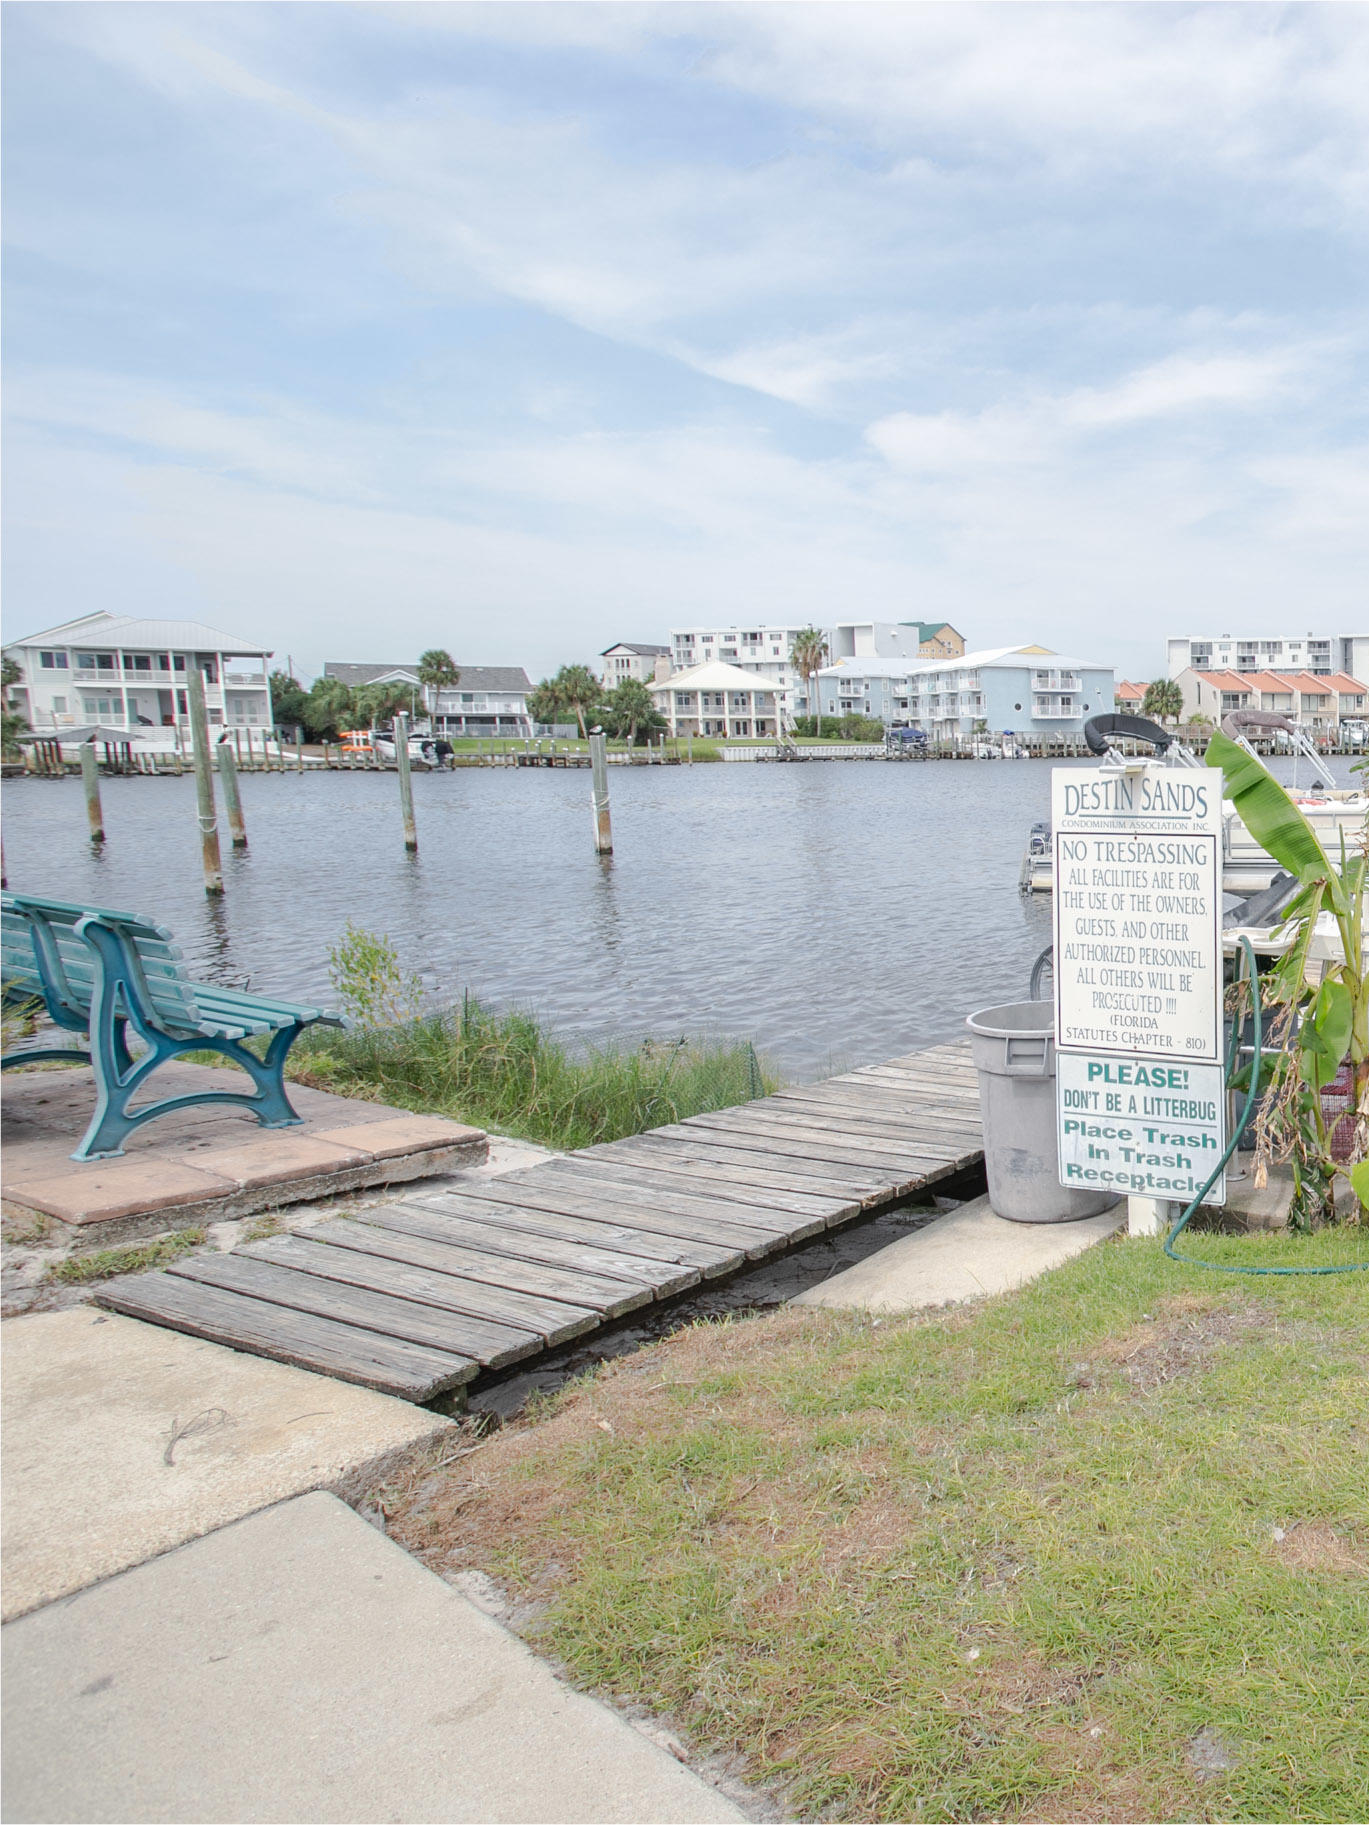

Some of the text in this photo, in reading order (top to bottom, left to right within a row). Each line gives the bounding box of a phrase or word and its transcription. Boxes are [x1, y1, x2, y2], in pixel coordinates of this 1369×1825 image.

[1065, 778, 1207, 818] DESTIN SANDS
[1062, 820, 1125, 829] CONDOMINIUM
[1129, 821, 1188, 830] ASSOCIATION
[1062, 840, 1207, 866] NO TRESPASSING
[1069, 868, 1200, 891] ALL FACILITIES ARE FOR
[1063, 891, 1084, 909] THE
[1088, 892, 1108, 910] USE
[1112, 893, 1125, 911] OF
[1130, 894, 1152, 912] THE
[1122, 921, 1147, 939] AND
[1150, 922, 1189, 942] OTHER
[1064, 943, 1206, 969] AUTHORIZED PERSONNEL.
[1076, 967, 1193, 993] ALL OTHERS WILL BE
[1092, 991, 1162, 1014] PROSECUTED
[1110, 1015, 1159, 1030] (FLORIDA
[1066, 1027, 1118, 1043] STATUTES
[1121, 1031, 1173, 1048] CHAPTER
[1185, 1037, 1206, 1050] 810)
[1087, 1062, 1189, 1090] PLEASE!
[1064, 1089, 1216, 1121] DON'T BE A LITTERBUG
[1063, 1119, 1217, 1149] Place Trash
[1088, 1144, 1192, 1169] In Trash
